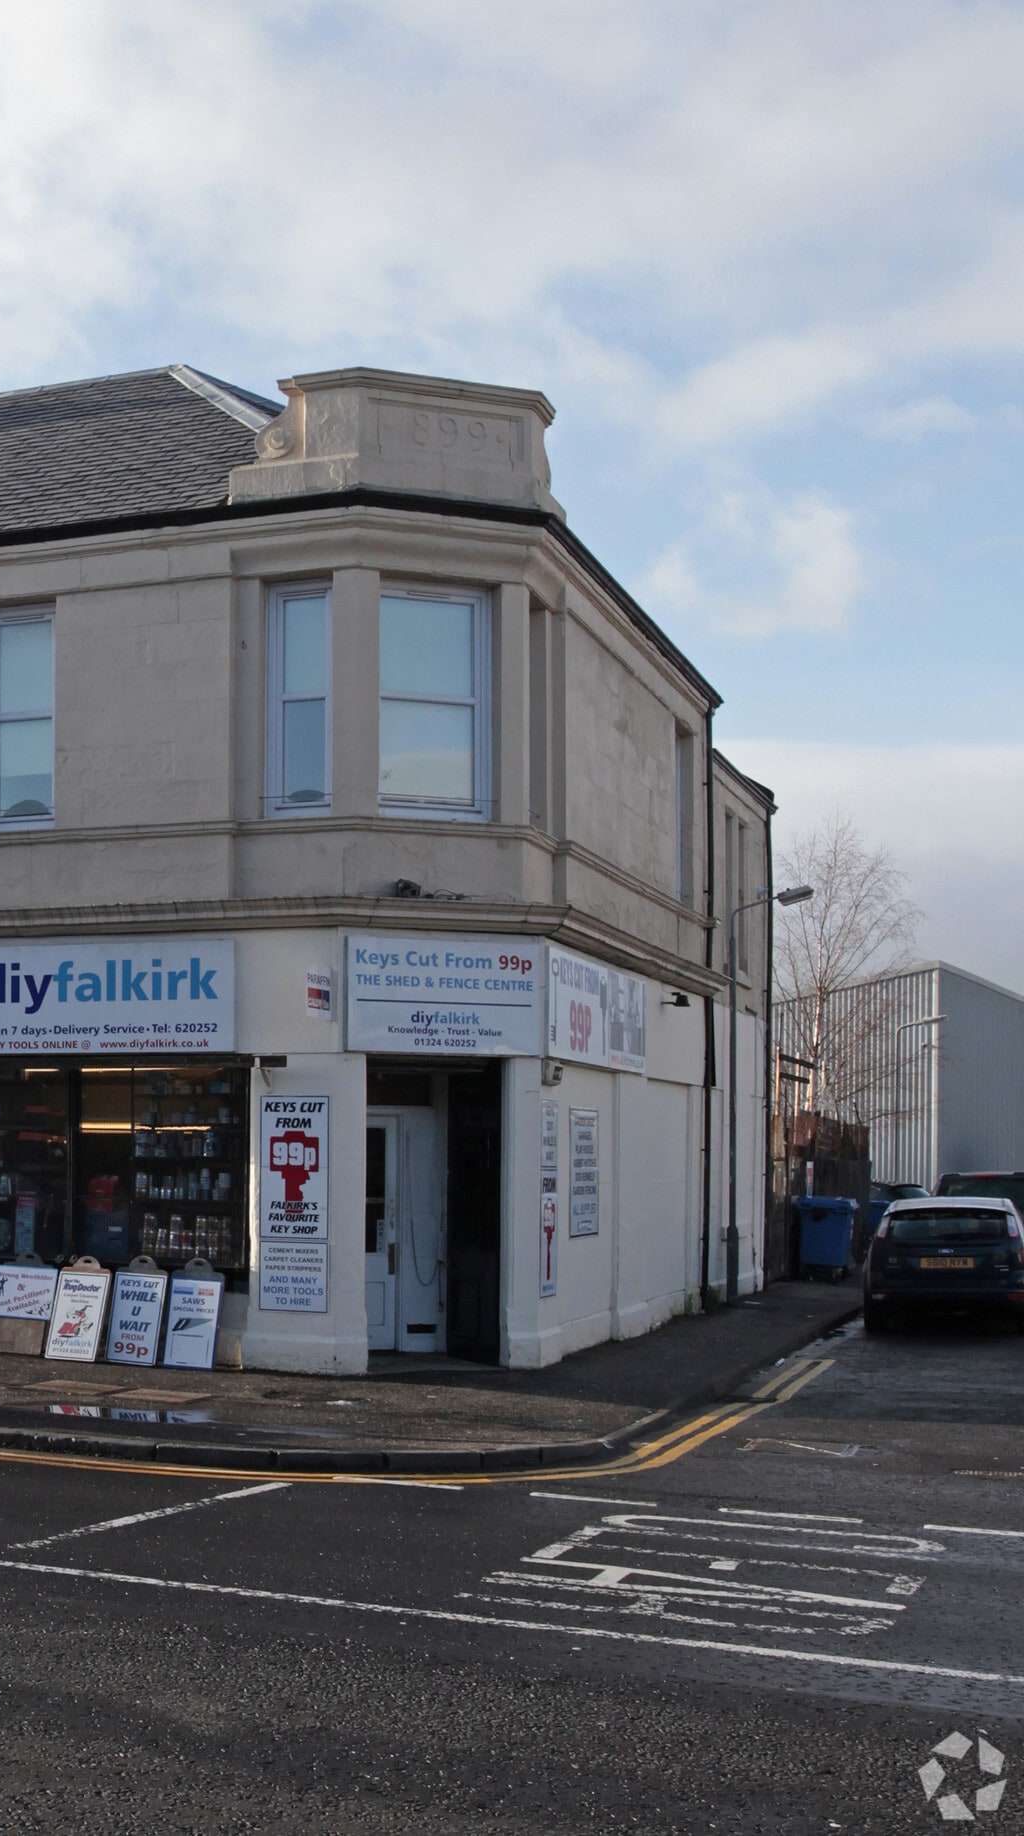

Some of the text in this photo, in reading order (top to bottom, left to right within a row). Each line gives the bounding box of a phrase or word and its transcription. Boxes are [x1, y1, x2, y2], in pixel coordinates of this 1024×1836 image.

[355, 949, 532, 975] Keys Cut From 99p
[356, 974, 533, 992] THE SHED & FENCE CENTRE
[411, 1010, 480, 1027] diyfalkirk
[11, 1026, 18, 1035] 7
[53, 1024, 100, 1037] Delivery
[104, 1024, 145, 1034] Service
[152, 1024, 171, 1033] Tel:
[175, 1022, 218, 1033] 620252
[388, 1026, 439, 1036] Knowledge
[447, 1027, 471, 1036] Trust
[478, 1028, 502, 1037] Value
[569, 999, 591, 1054] 99P
[8, 1041, 39, 1050] TOOLS
[42, 1040, 77, 1050] ONLINE
[81, 1040, 91, 1050] @
[100, 1038, 209, 1050] www.diyfalkirk.co.uk
[414, 1038, 476, 1048] 01324 620252
[264, 1101, 325, 1113] KEYS CUT
[275, 1117, 312, 1129] FROM
[273, 1141, 316, 1170] 99p
[270, 1200, 318, 1211] FALKIRK'S
[268, 1213, 319, 1223] FAVOURITE
[270, 1225, 318, 1235] KEY SHOP
[290, 1256, 323, 1264] CLEANERS
[287, 1265, 321, 1273] STRIPPERS
[120, 1279, 160, 1289] KEYS CUT
[269, 1276, 318, 1285] AND MANY
[17, 1283, 26, 1291] &
[263, 1285, 324, 1296] MORE TOOLS
[13, 1288, 51, 1303] Fertilisers
[120, 1290, 158, 1303] WHILE
[275, 1296, 311, 1306] TO HIRE
[6, 1299, 40, 1313] Available
[131, 1306, 141, 1316] U
[119, 1320, 151, 1332] WAIT
[52, 1338, 92, 1347] diyfalkirk
[121, 1333, 144, 1341] FROM
[114, 1342, 148, 1358] 99p
